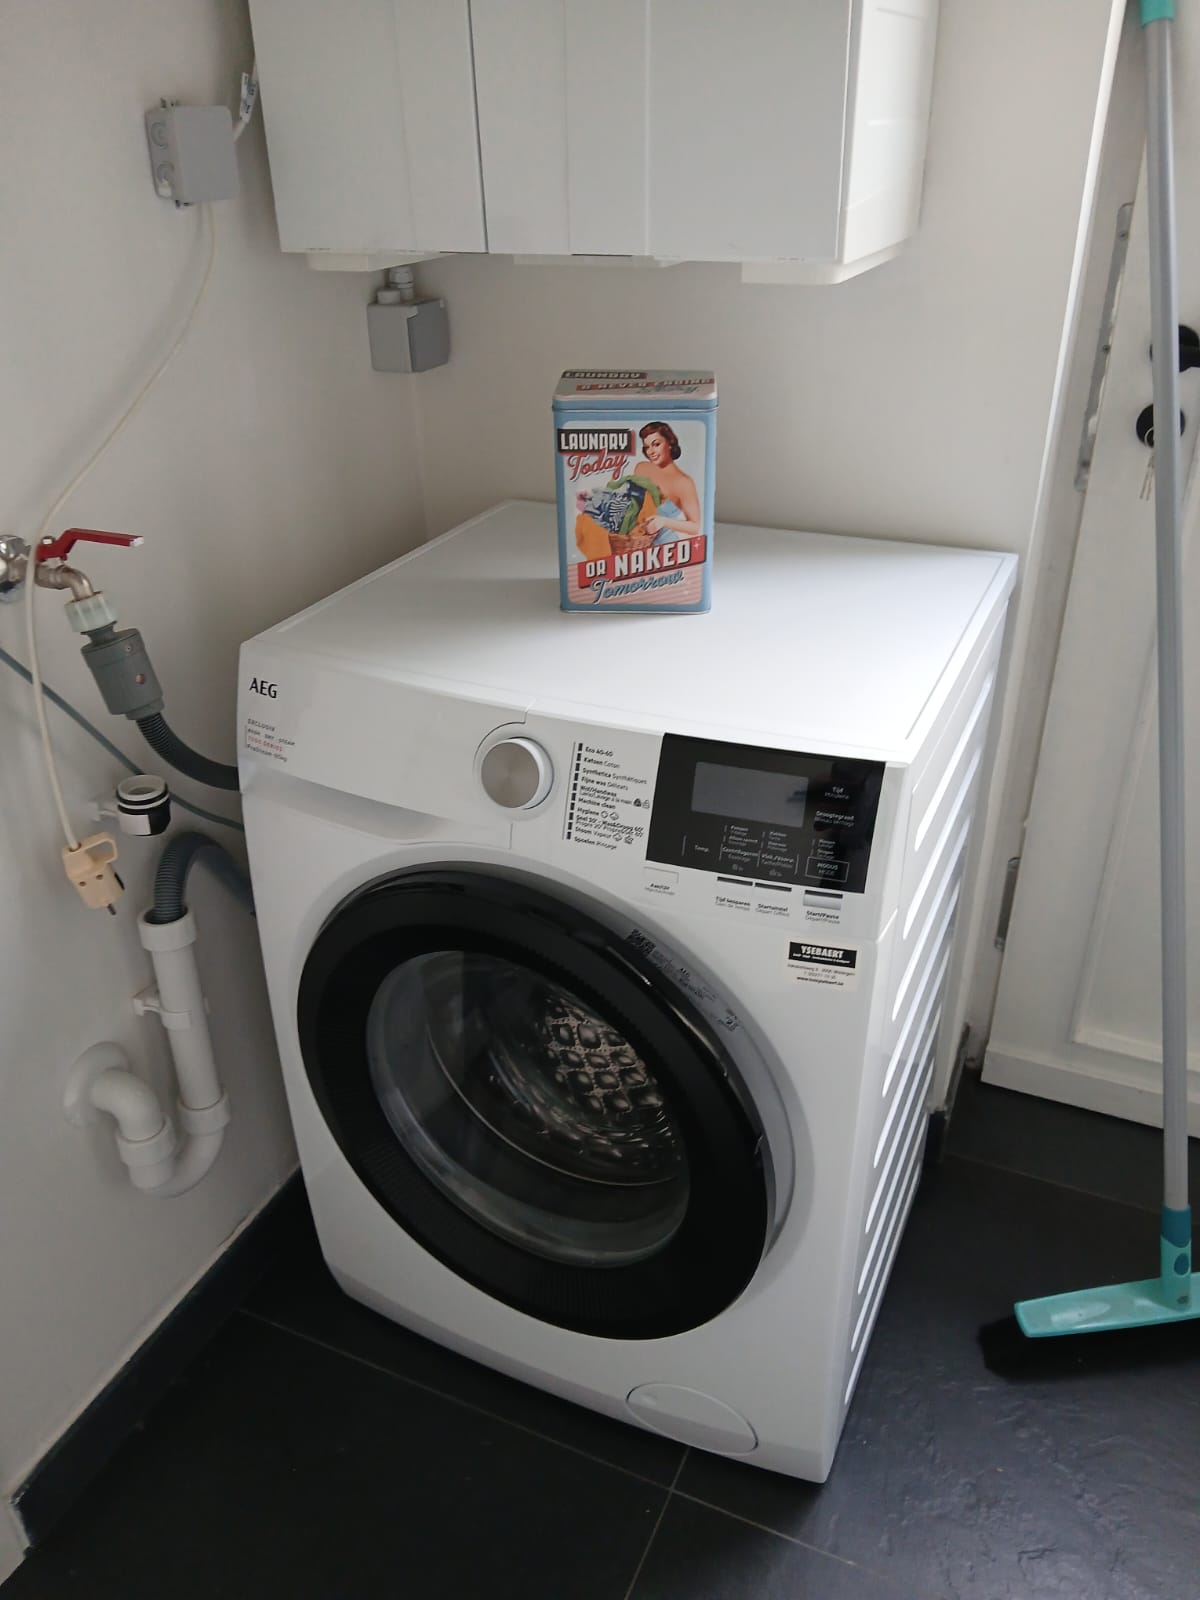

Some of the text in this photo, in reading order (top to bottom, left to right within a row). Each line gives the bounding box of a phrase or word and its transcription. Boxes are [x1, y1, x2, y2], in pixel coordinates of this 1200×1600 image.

[560, 432, 629, 451] LAUNDRY
[567, 448, 629, 481] Today
[585, 540, 691, 579] OR NAKED
[590, 569, 685, 604] Tomorrow
[249, 677, 278, 699] AEG
[800, 945, 845, 960] YSEBAERT
